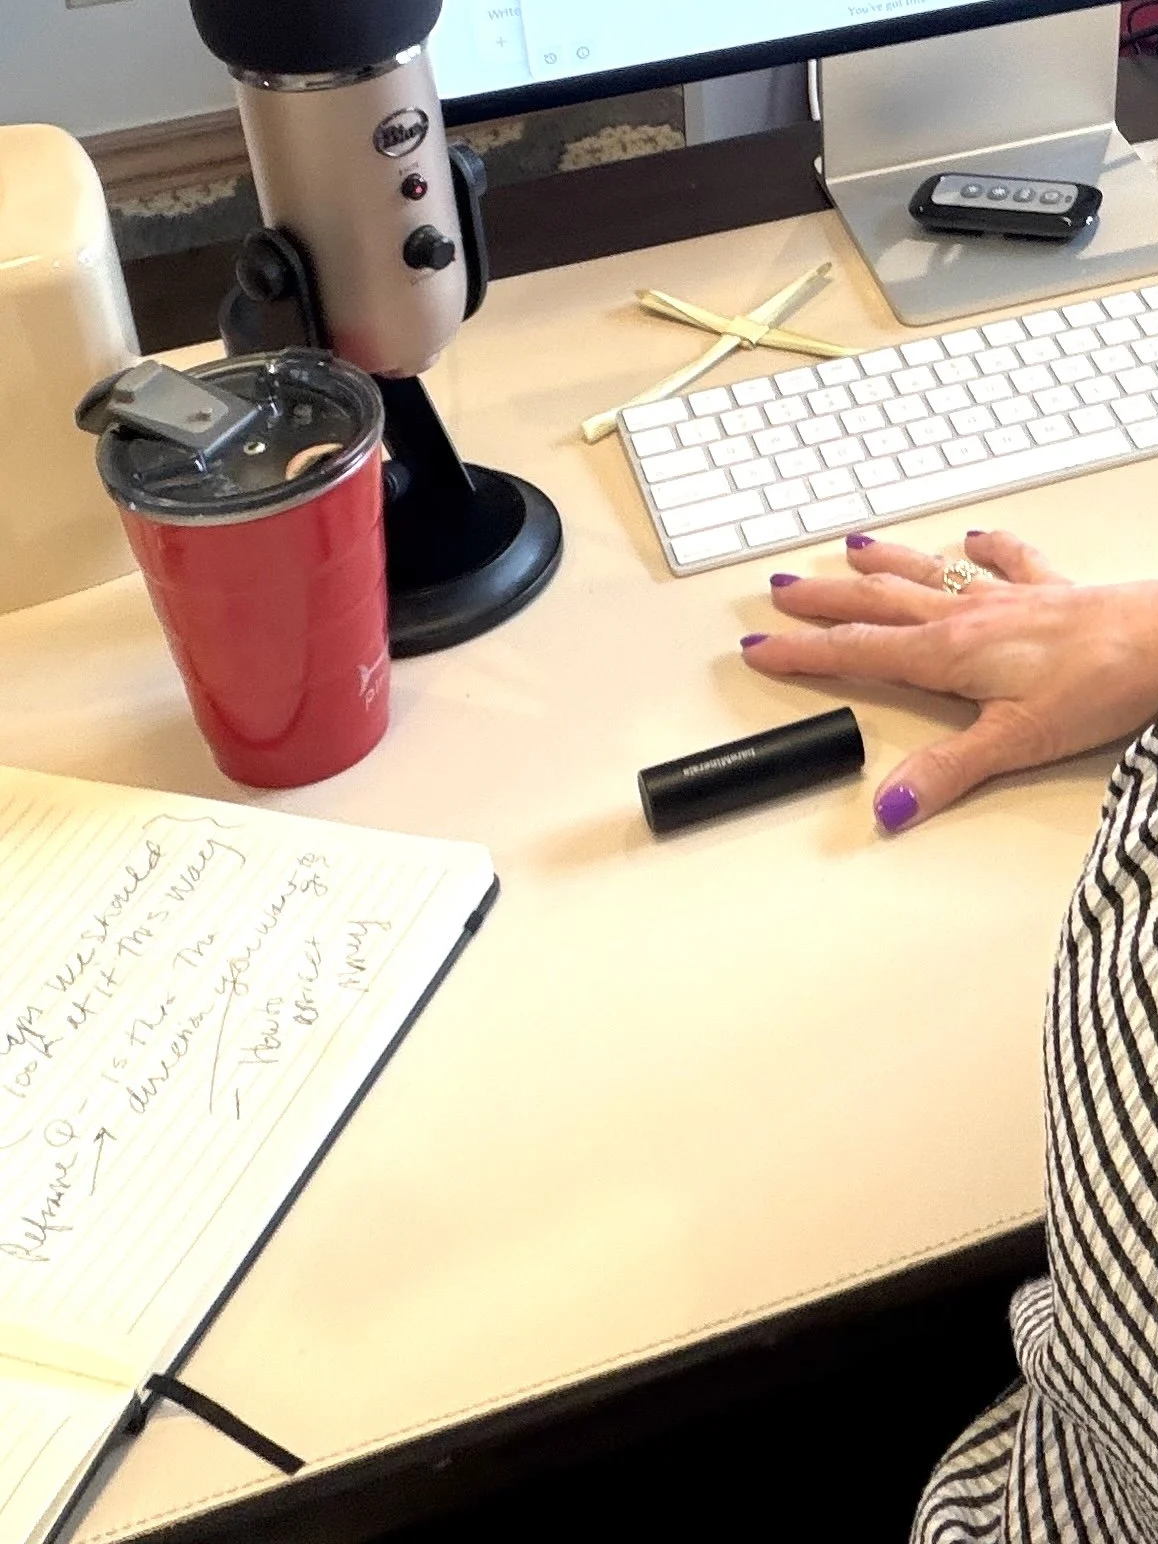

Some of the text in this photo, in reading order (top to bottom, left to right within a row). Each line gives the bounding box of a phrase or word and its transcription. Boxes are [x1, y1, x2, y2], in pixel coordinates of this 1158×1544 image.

[488, 7, 521, 20] Write
[847, 0, 902, 16] You've got
